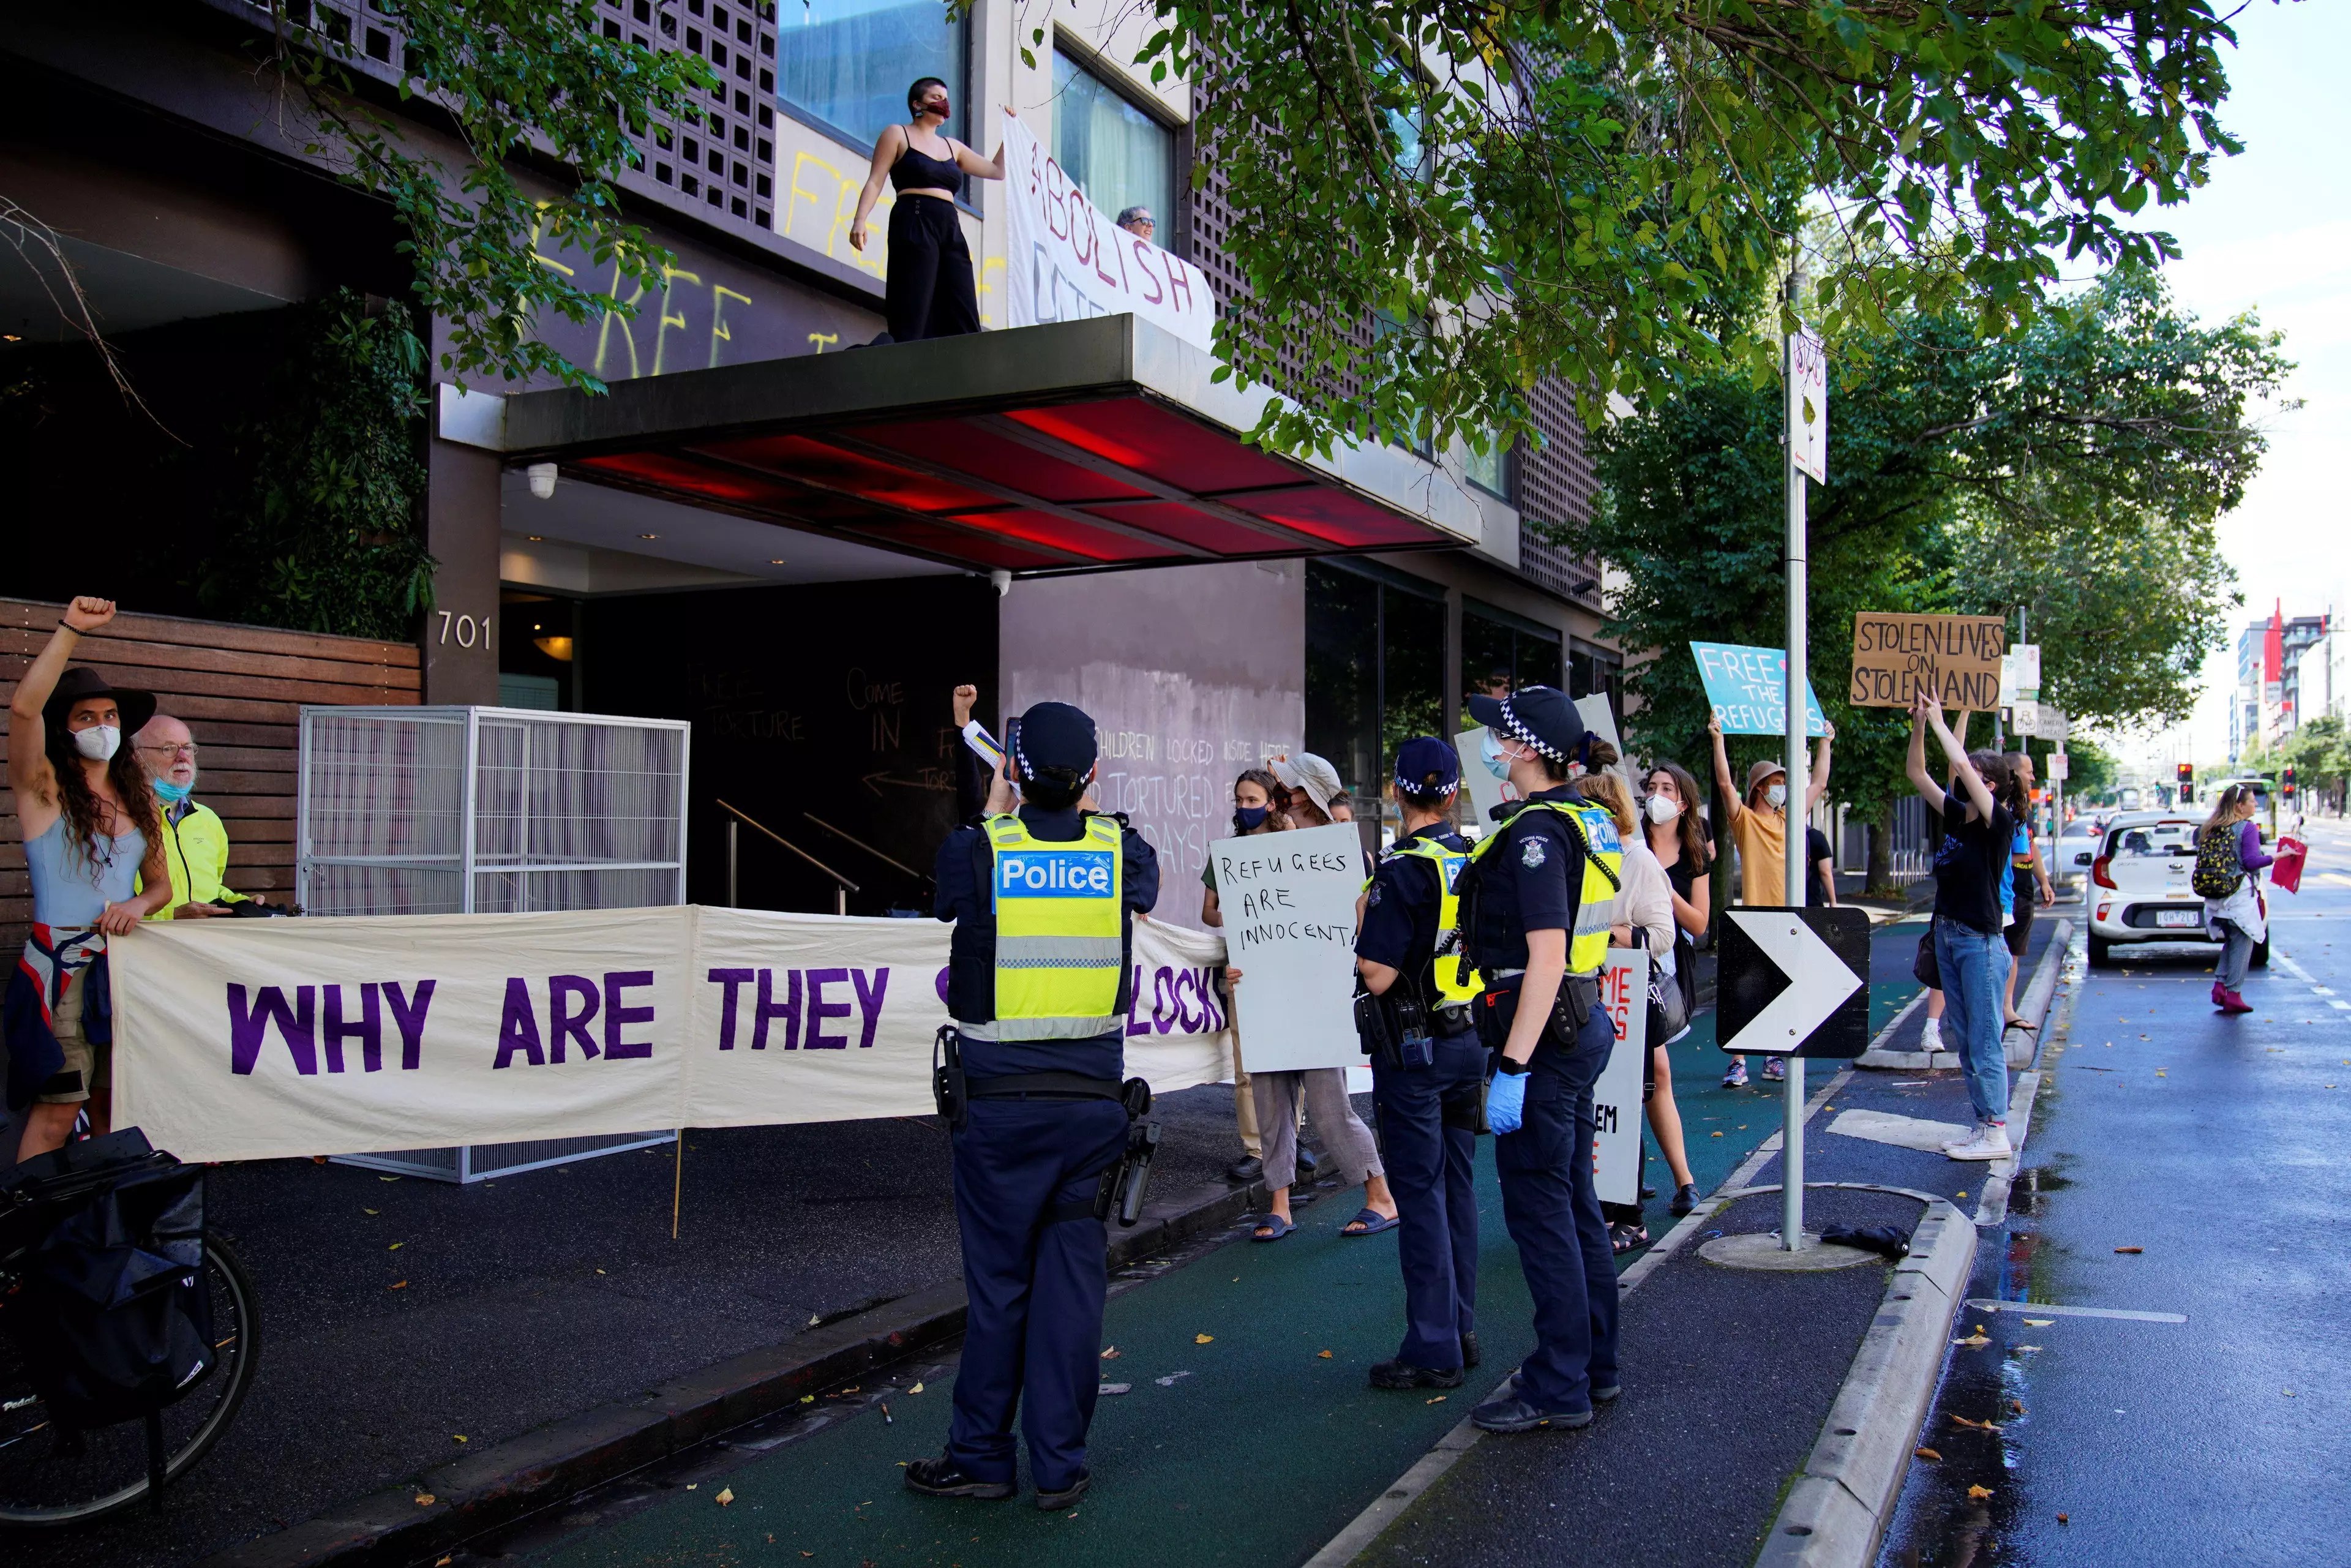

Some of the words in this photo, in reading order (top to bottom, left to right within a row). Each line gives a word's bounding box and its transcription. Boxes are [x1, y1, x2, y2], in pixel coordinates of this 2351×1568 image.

[1032, 141, 1191, 315] ABOLISH
[438, 610, 490, 650] 701
[1859, 621, 1942, 654] STOLEN
[1947, 621, 2004, 661] LIVES
[1699, 648, 1782, 685] FREE
[1908, 653, 1935, 674] ON
[847, 667, 904, 710] COME
[1741, 684, 1783, 705] THE
[1852, 667, 1932, 705] STOLEN
[1935, 667, 2000, 709] LAND
[703, 703, 805, 743] TORTURE
[872, 708, 901, 751] IN
[1167, 738, 1214, 765] LOCKED
[1108, 771, 1214, 820] TORTURED
[1003, 860, 1108, 890] Police
[1222, 853, 1346, 885] REFUGEES
[1244, 889, 1295, 919] ARE
[1240, 921, 1348, 950] INNOCENT
[227, 980, 437, 1076] WHY
[492, 970, 654, 1069] ARE
[708, 967, 890, 1051] THEY
